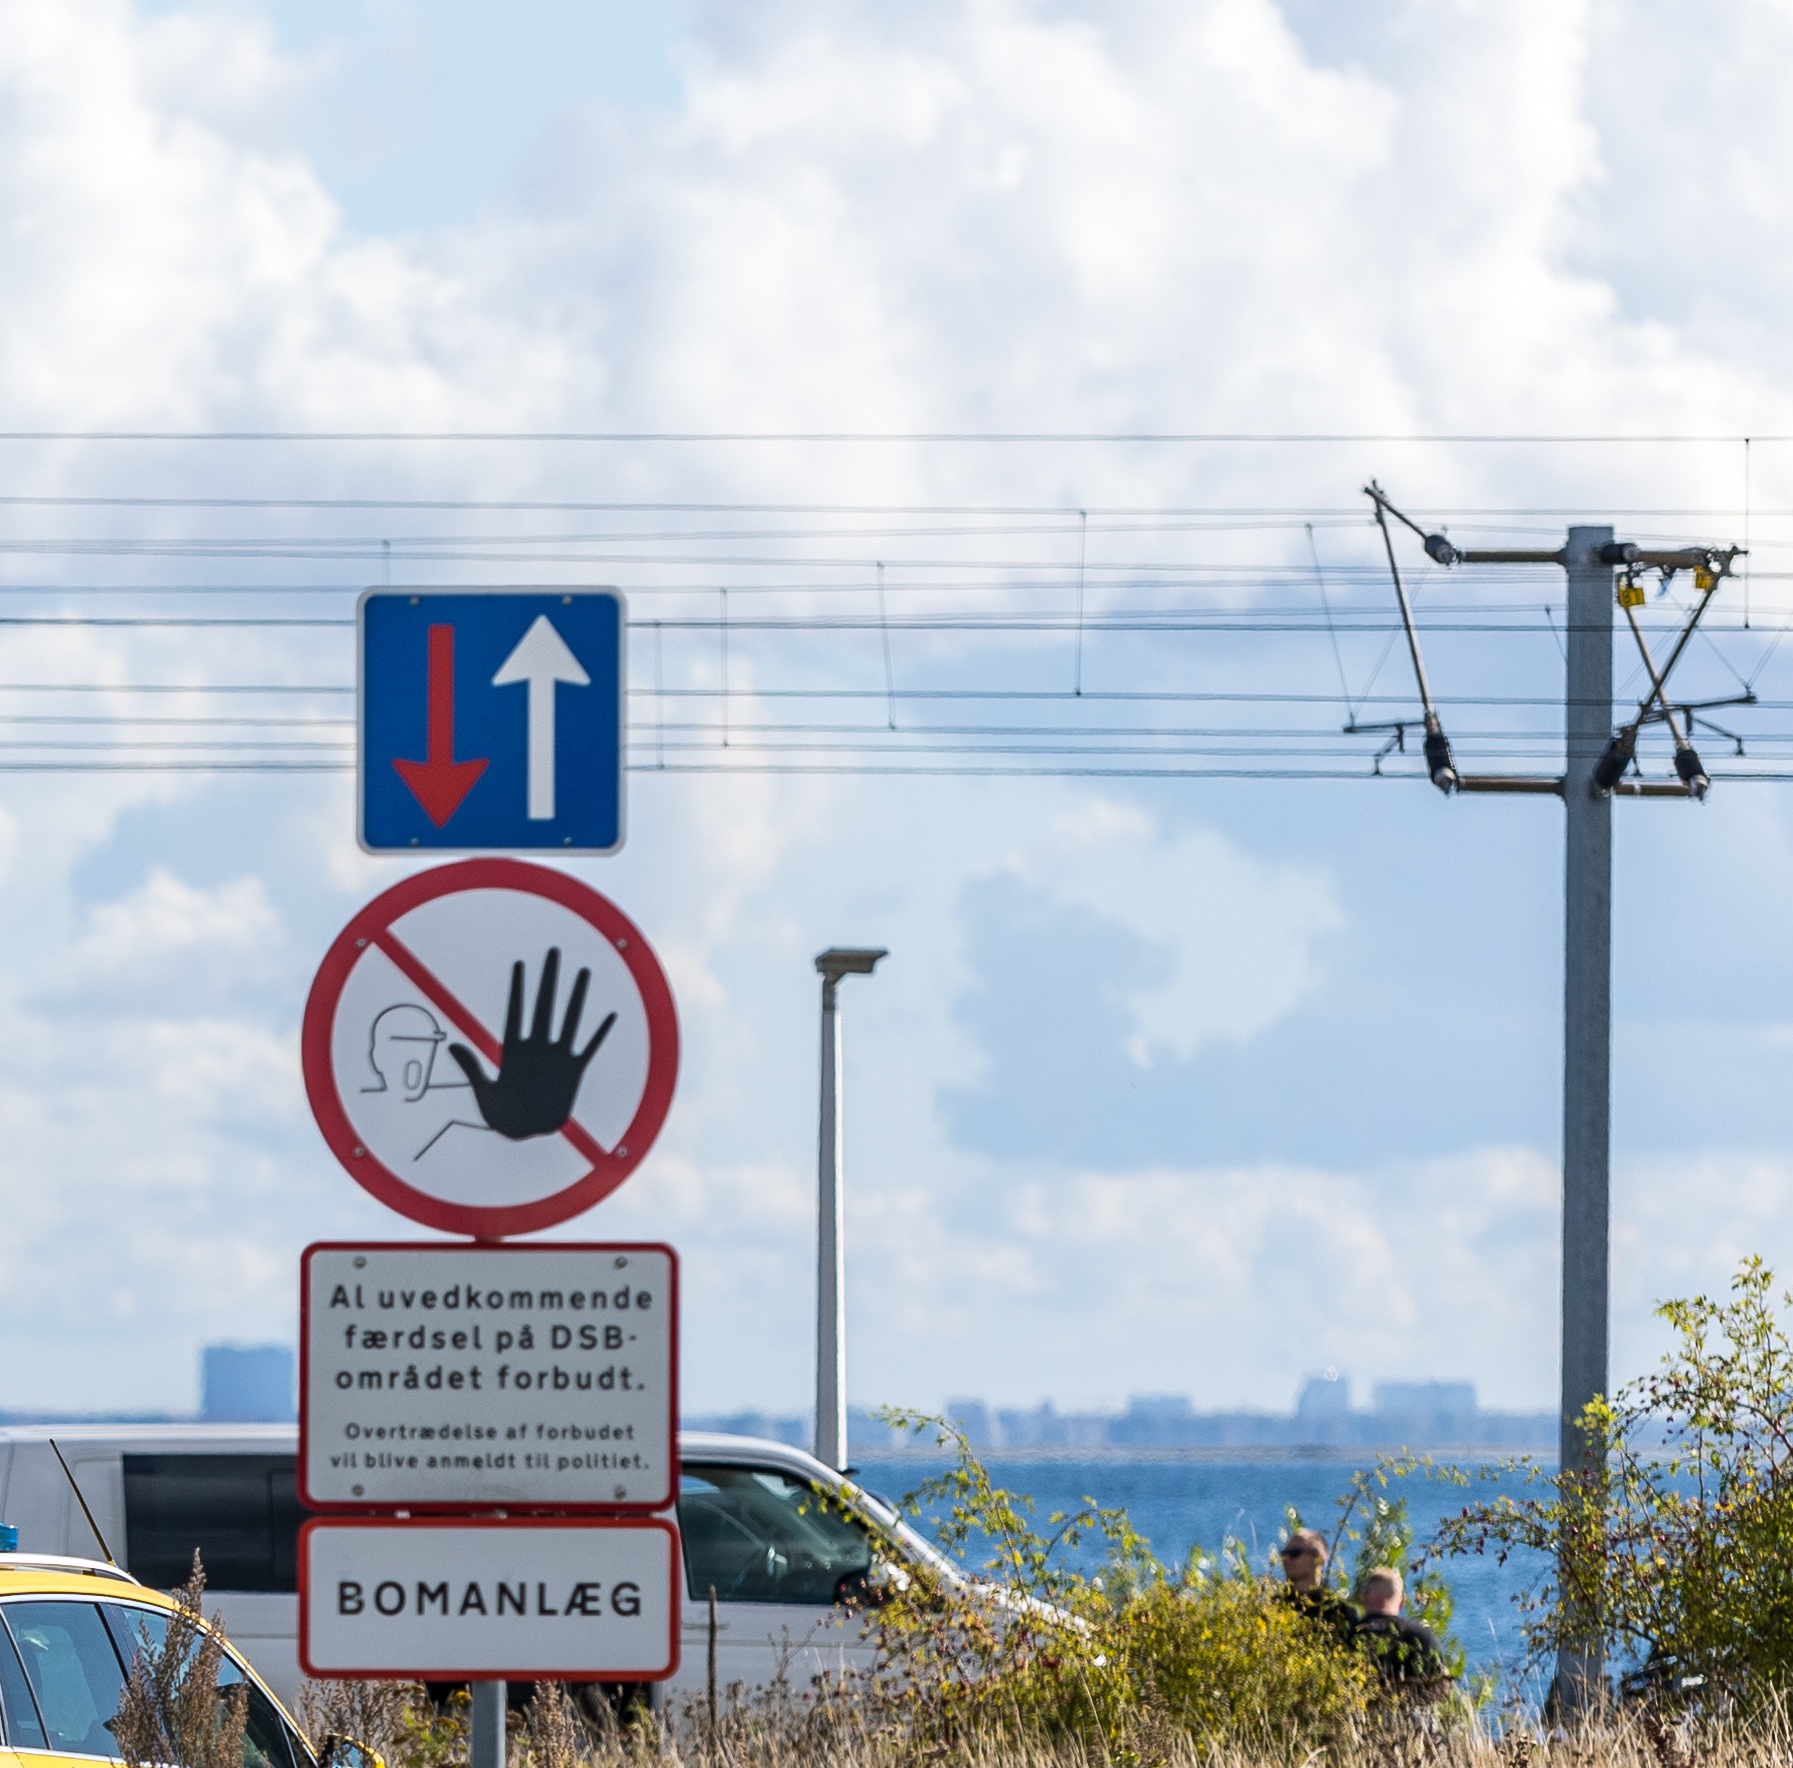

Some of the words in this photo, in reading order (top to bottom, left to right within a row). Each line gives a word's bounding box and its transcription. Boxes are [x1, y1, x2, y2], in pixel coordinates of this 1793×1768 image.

[330, 1284, 365, 1309] Al
[378, 1284, 653, 1310] uvedkommende
[345, 1324, 482, 1350] færdsel
[496, 1324, 534, 1354] på
[551, 1324, 637, 1350] DSB-
[336, 1364, 482, 1390] området
[497, 1364, 646, 1390] forbudt.
[344, 1422, 497, 1440] Overtrædelse
[505, 1423, 527, 1440] af
[536, 1423, 635, 1440] forbudet
[330, 1452, 357, 1468] vil
[365, 1452, 419, 1469] blive
[426, 1452, 516, 1469] anmeldt
[525, 1452, 550, 1469] til
[557, 1452, 650, 1471] politiet.
[338, 1581, 641, 1617] BOMANLÆG
